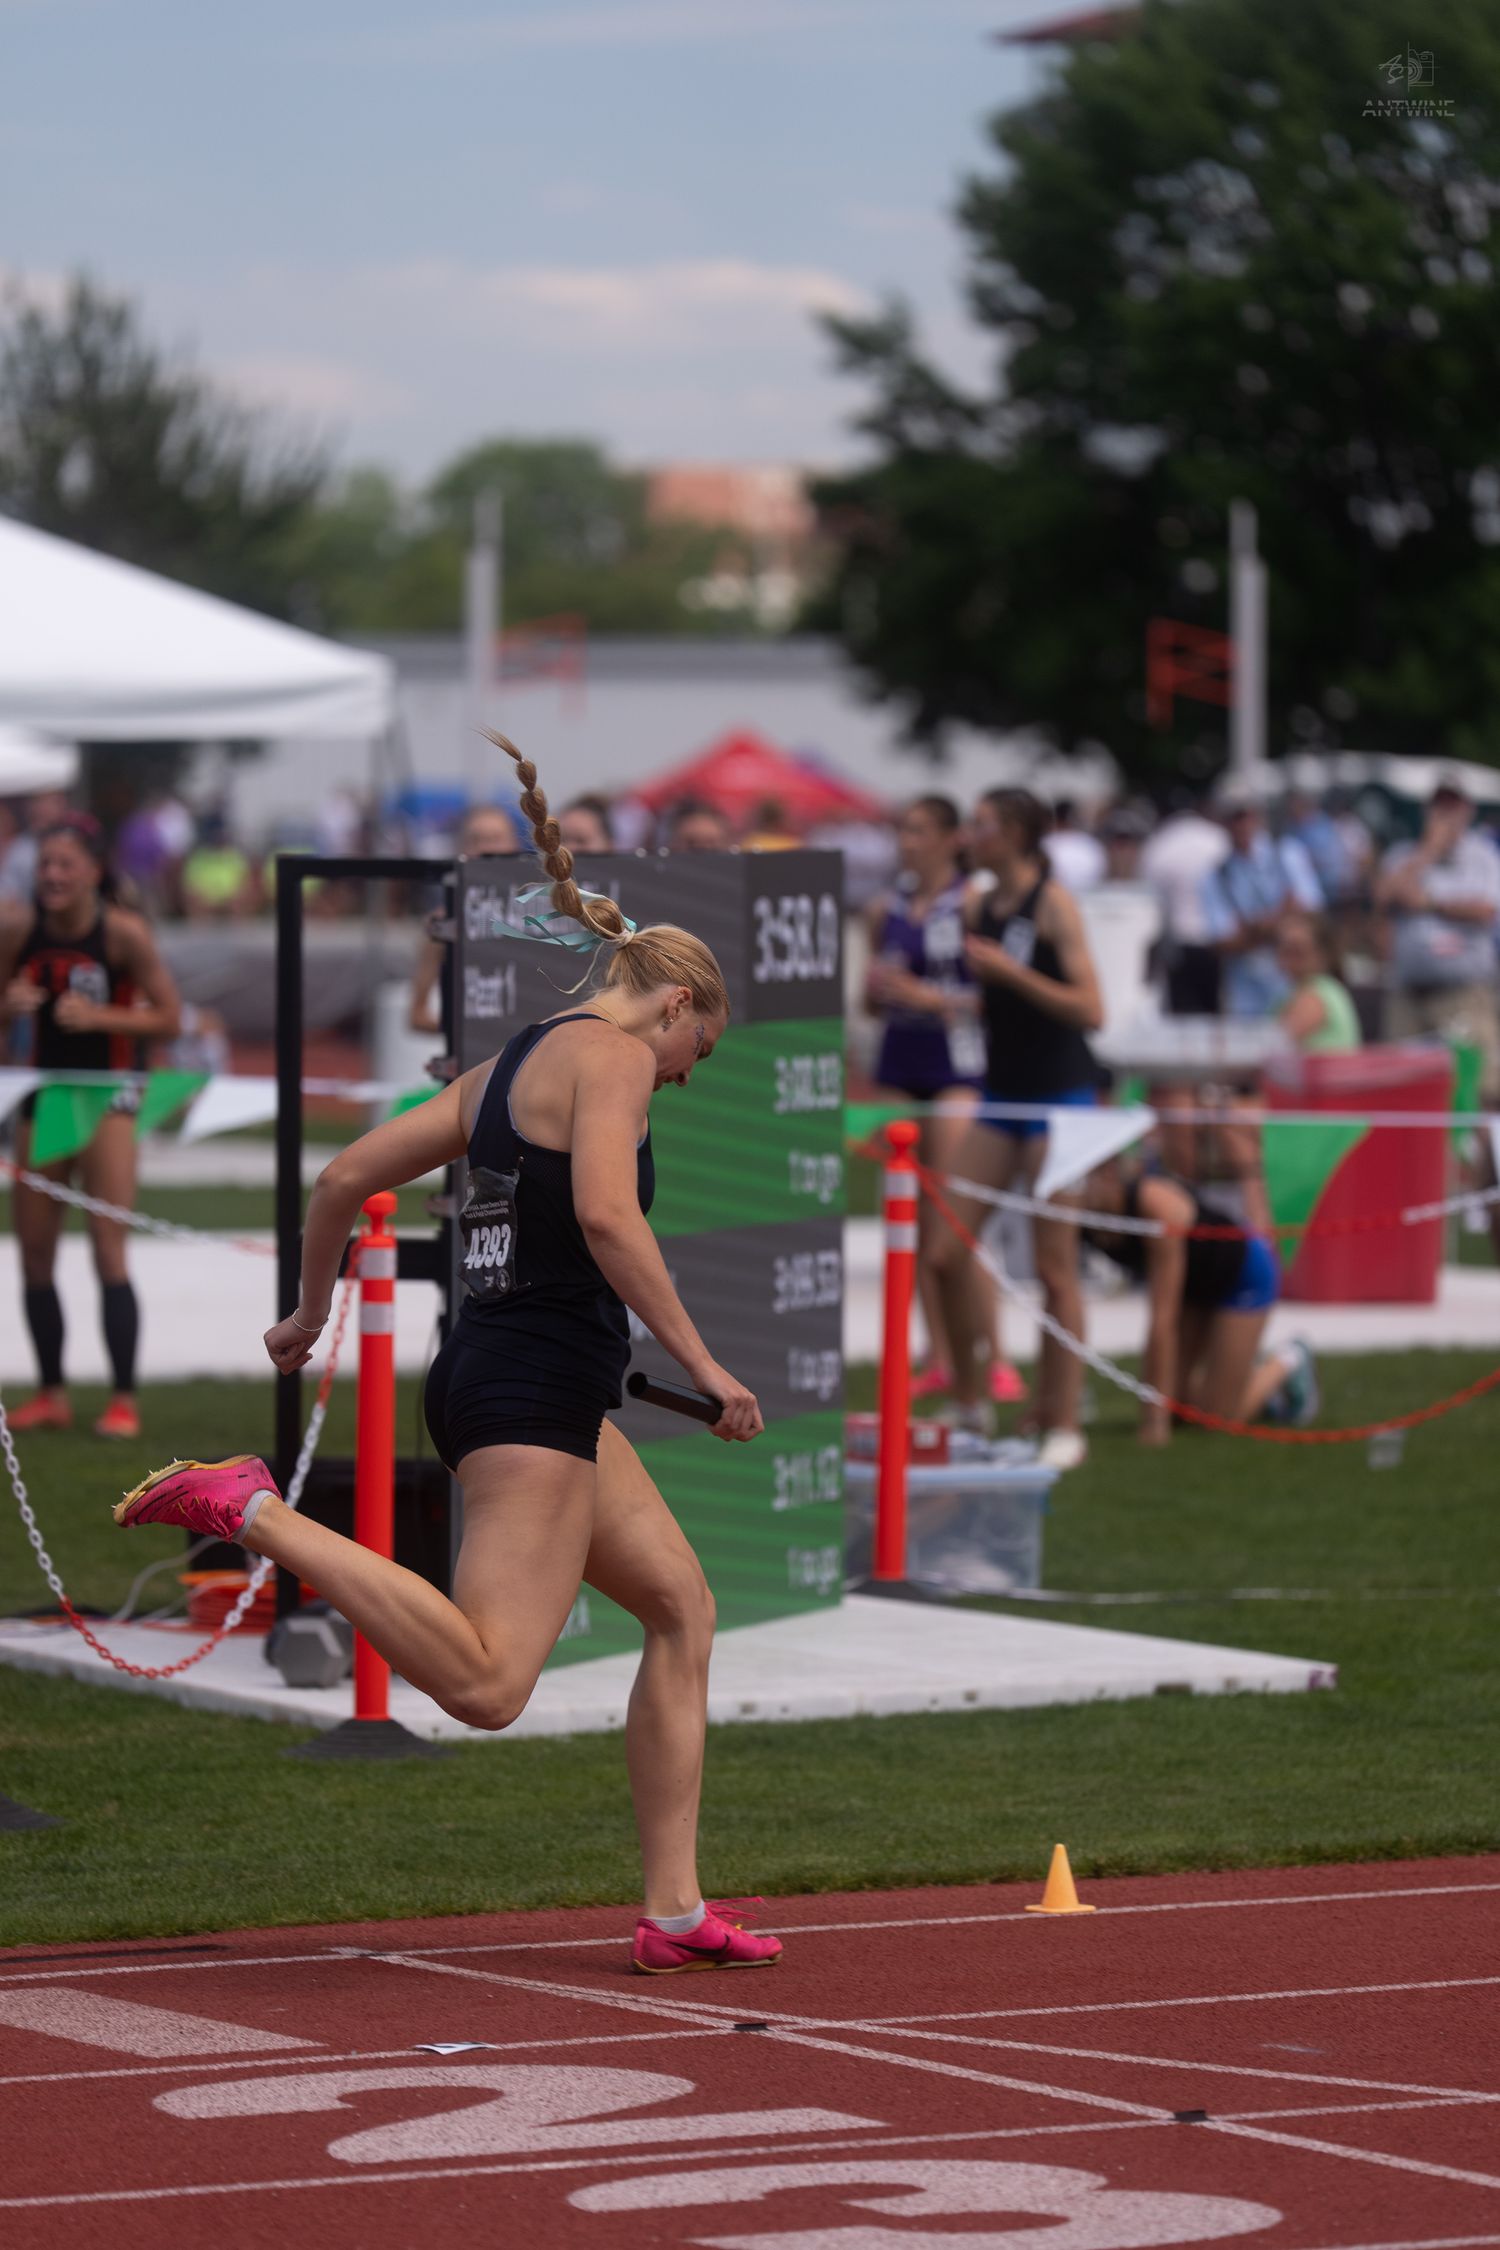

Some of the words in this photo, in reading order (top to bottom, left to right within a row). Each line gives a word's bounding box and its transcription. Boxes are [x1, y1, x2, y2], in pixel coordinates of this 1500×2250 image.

[464, 1223, 511, 1269] 4393
[152, 2064, 893, 2163] 2
[567, 2160, 1283, 2250] 3
